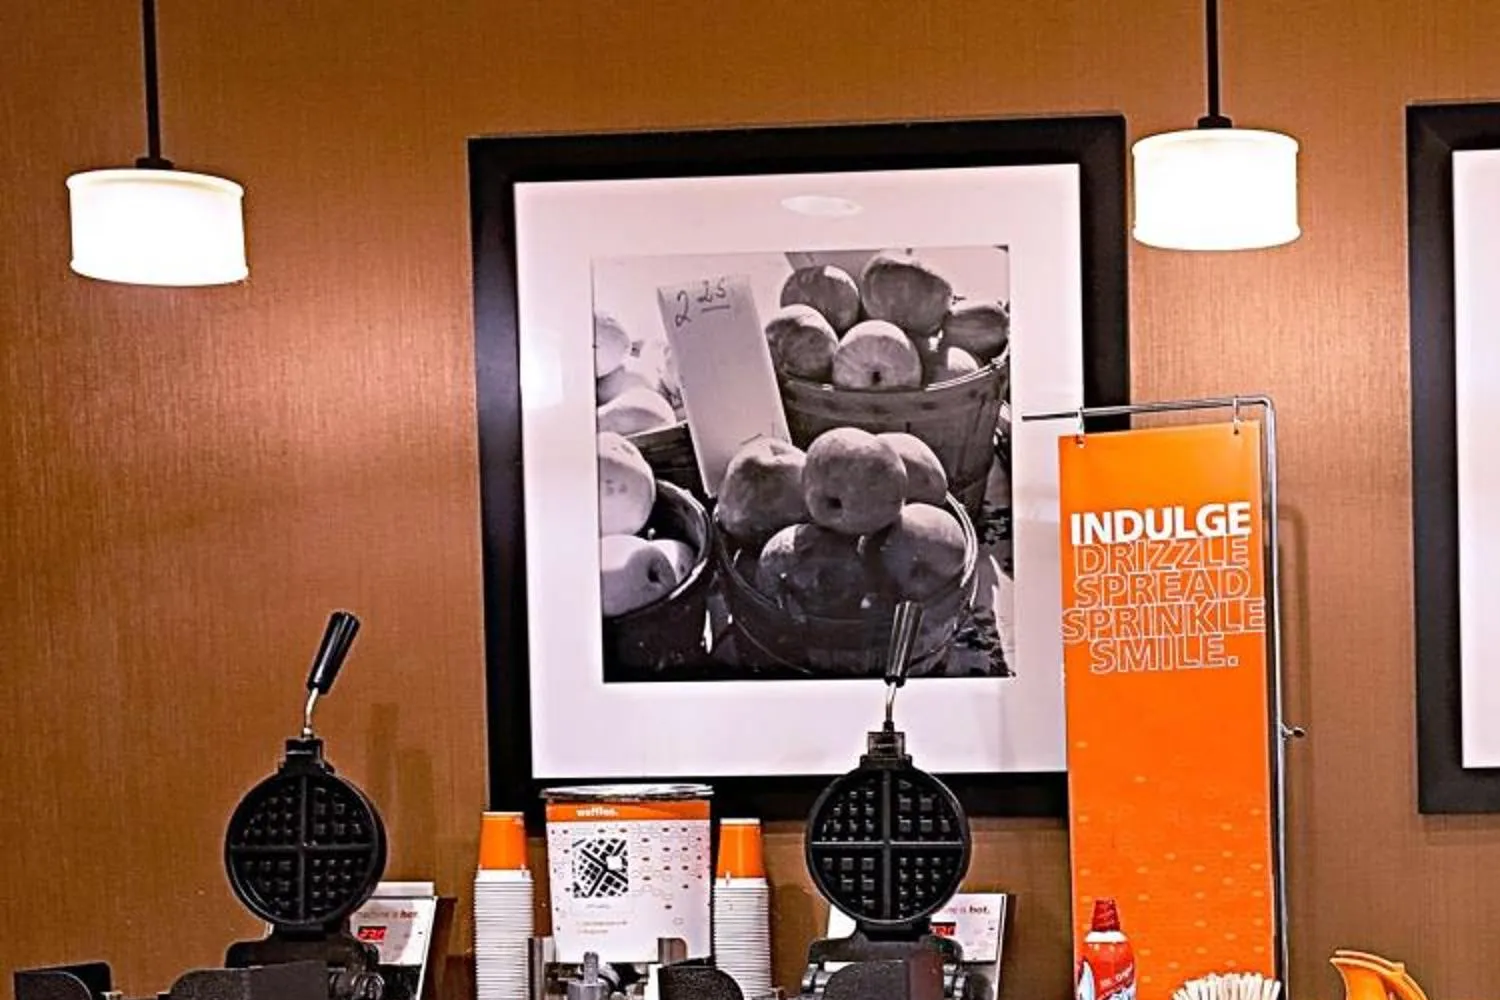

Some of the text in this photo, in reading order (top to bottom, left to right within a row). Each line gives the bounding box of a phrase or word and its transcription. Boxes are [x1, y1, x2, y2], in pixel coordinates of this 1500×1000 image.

[1070, 502, 1252, 545] INDULGE
[1074, 536, 1249, 576] DRIZZLE
[1073, 567, 1250, 609] SPREAD
[1061, 597, 1266, 643] SPRINKLE
[1089, 632, 1239, 675] SMILE.
[969, 904, 991, 914] hot.
